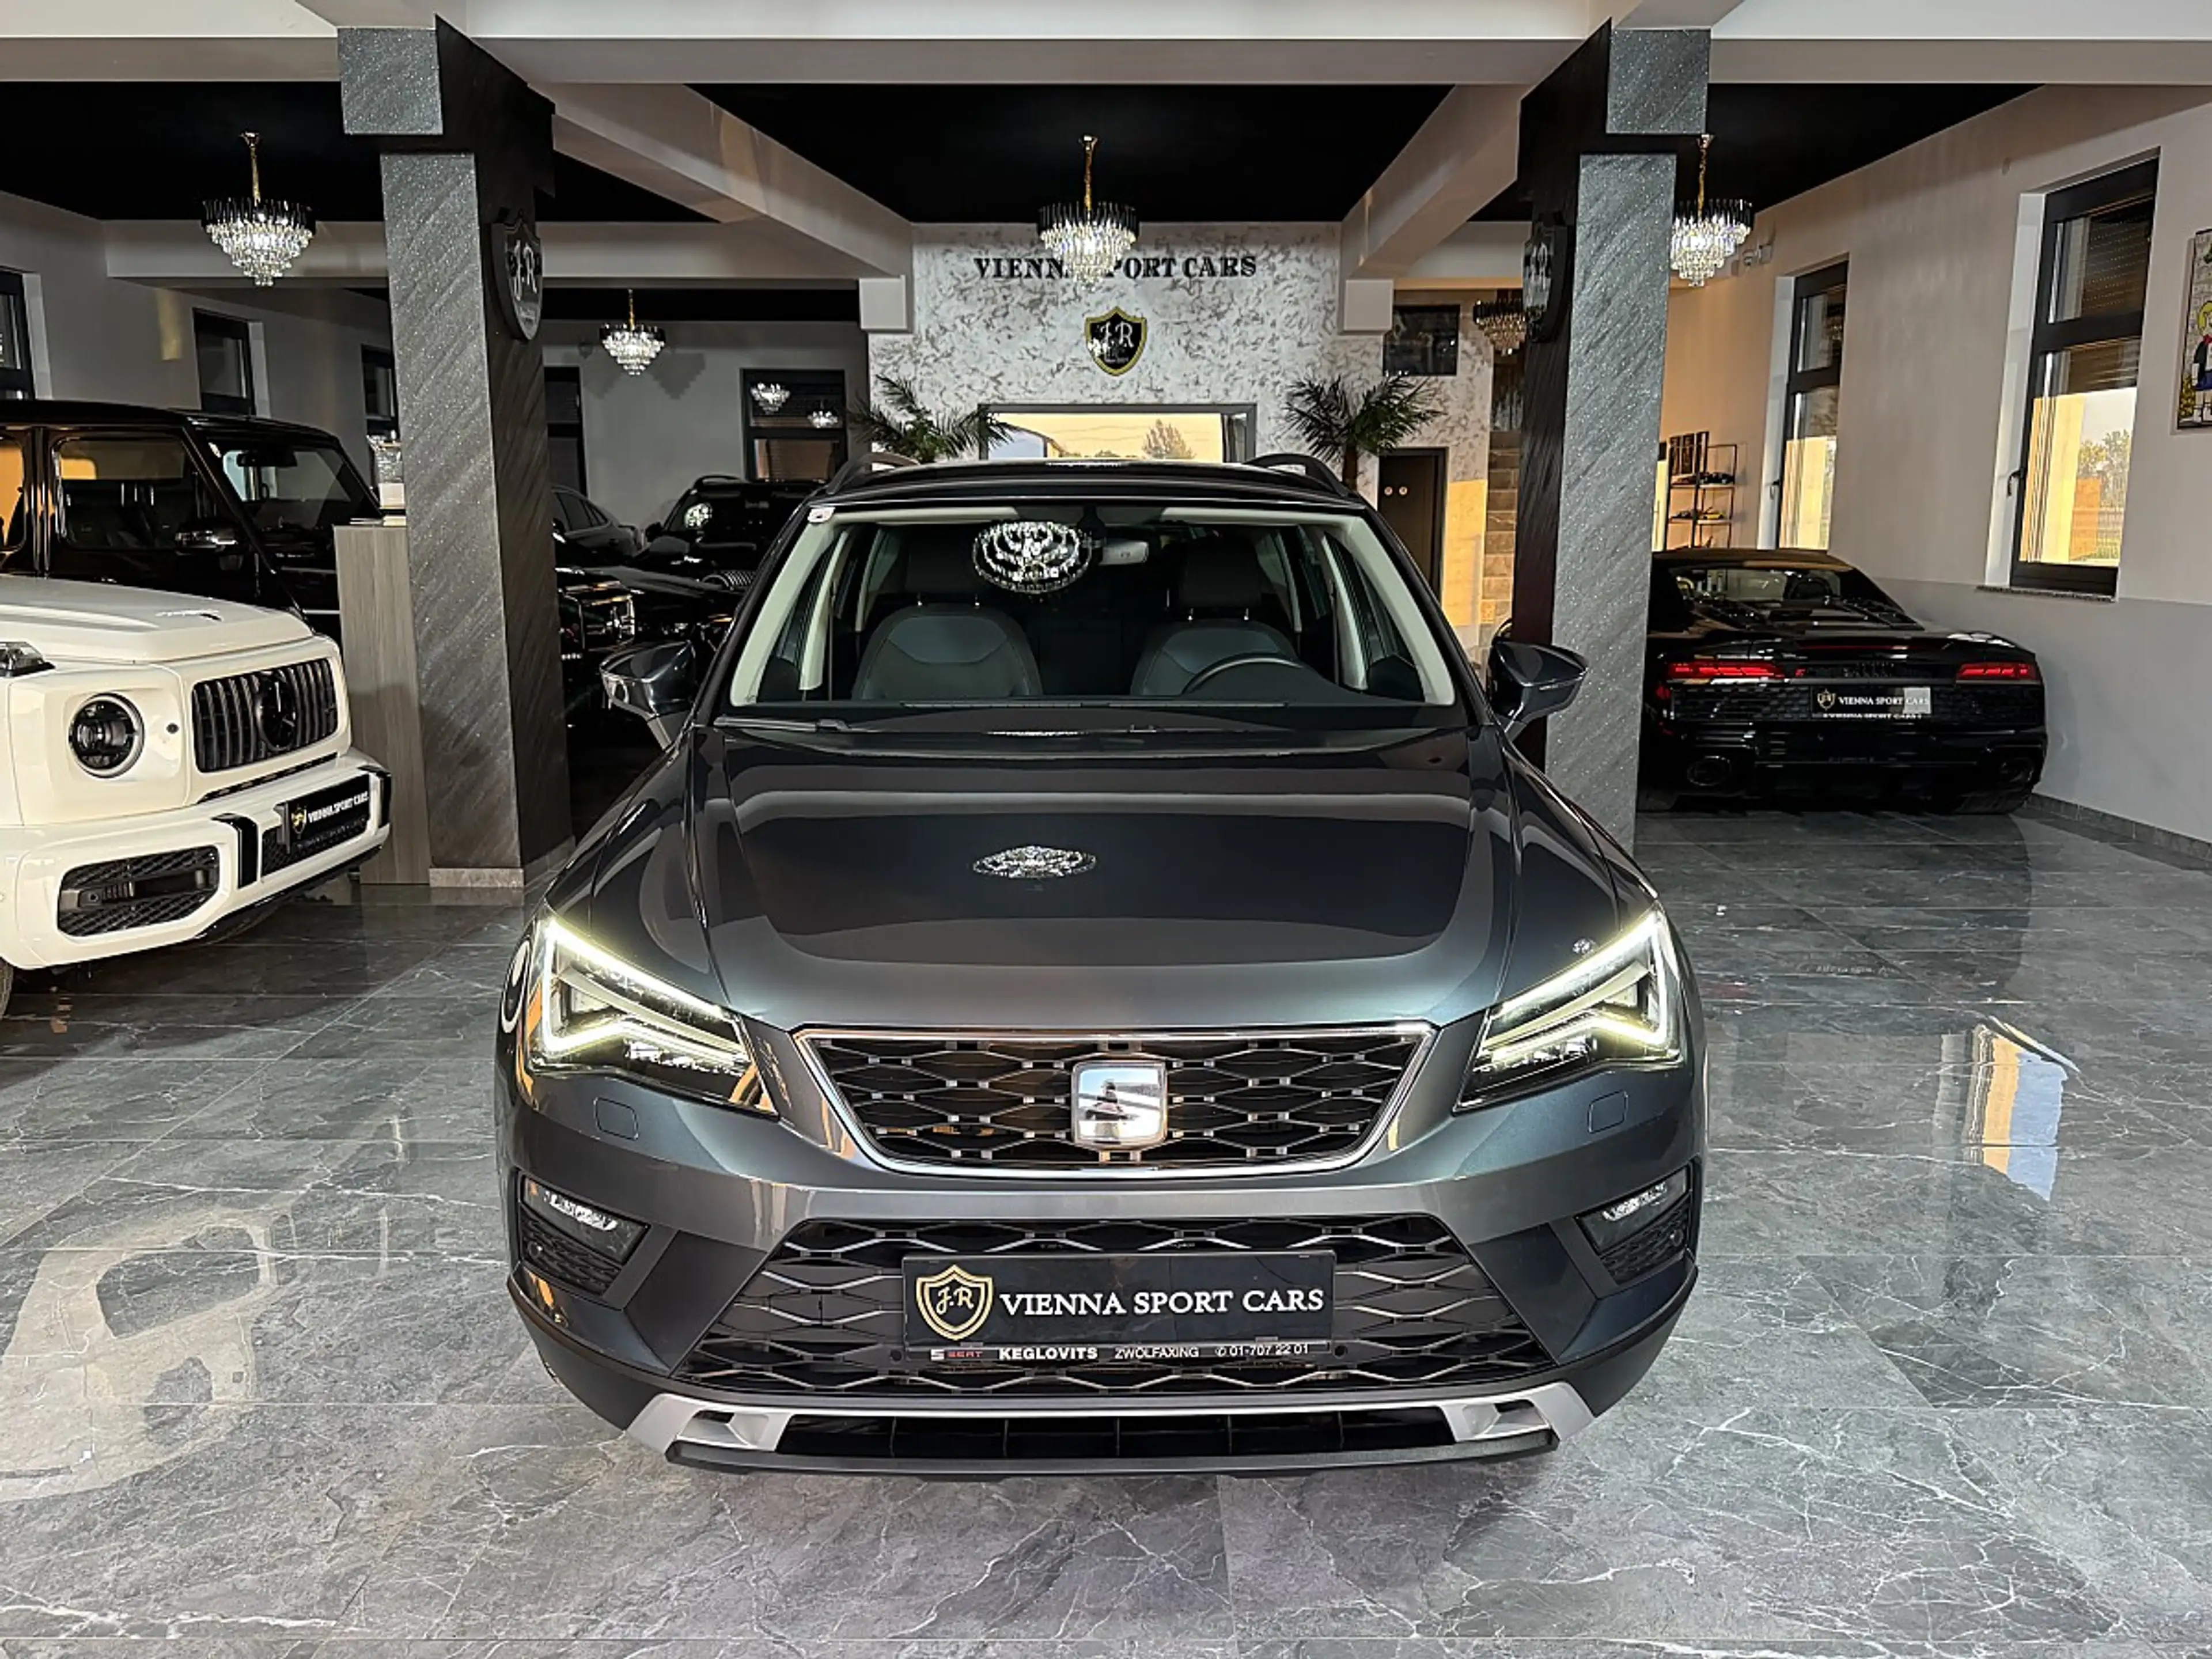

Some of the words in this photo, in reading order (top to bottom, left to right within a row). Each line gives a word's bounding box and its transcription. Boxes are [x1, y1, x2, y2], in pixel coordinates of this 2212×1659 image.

[974, 257, 1069, 279] VIENN
[1103, 257, 1177, 279] ORT
[1183, 255, 1256, 278] CARS
[1838, 696, 1874, 705] VIENNA
[1875, 696, 1903, 705] SPORT
[999, 1292, 1127, 1316] VIENNA
[1134, 1290, 1234, 1315] SPORT
[1242, 1288, 1324, 1312] CARS
[999, 1347, 1098, 1361] KEGLOVITS
